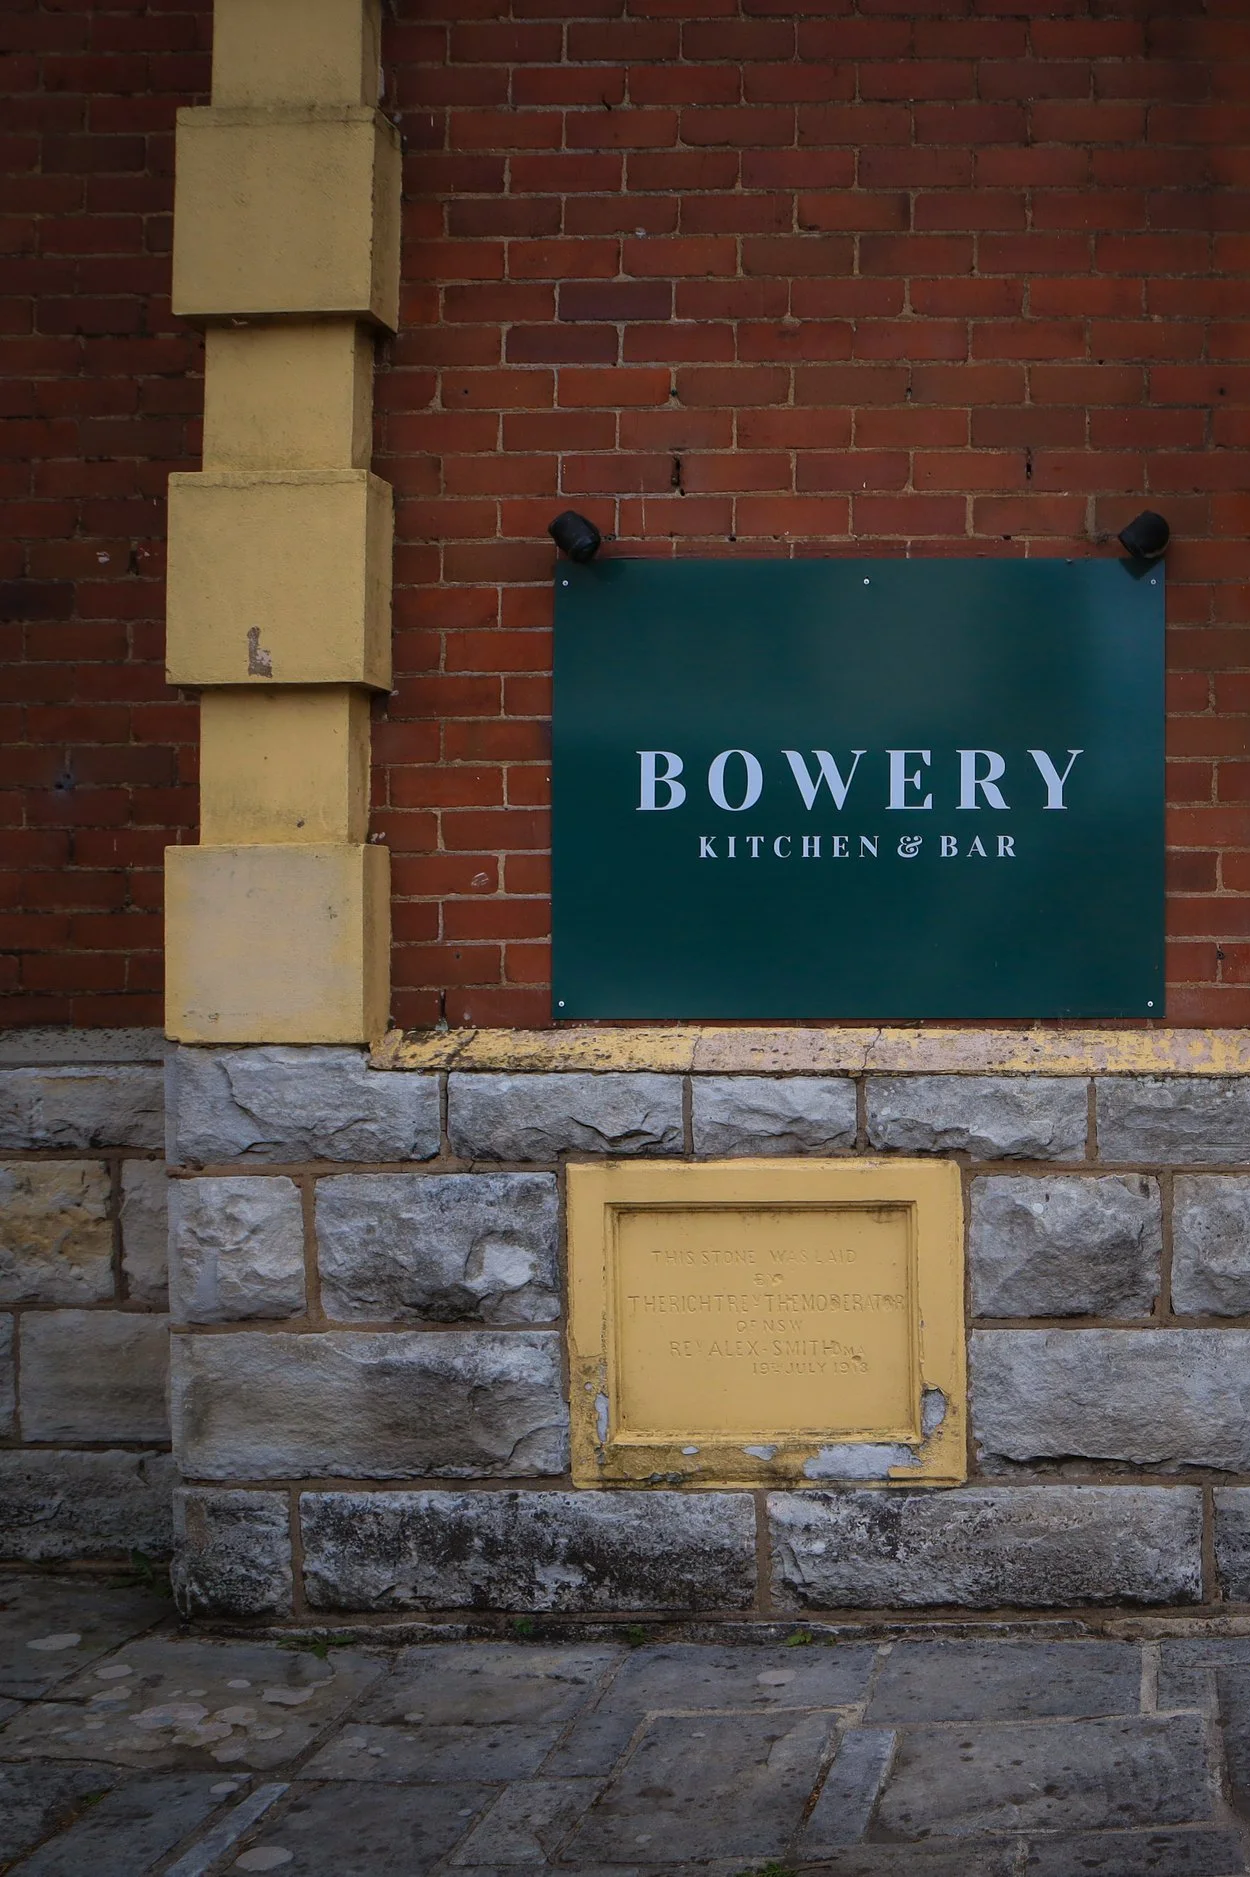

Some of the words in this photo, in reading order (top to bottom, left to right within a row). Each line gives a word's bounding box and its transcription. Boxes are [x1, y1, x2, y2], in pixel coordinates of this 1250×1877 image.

[635, 749, 1084, 811] BOWERY
[699, 836, 880, 859] KITCHEN
[897, 835, 923, 858] &
[940, 835, 1017, 858] BAR
[651, 1250, 695, 1265] THIS
[700, 1250, 757, 1265] STONE
[769, 1249, 809, 1264] WAS
[815, 1249, 857, 1264] LAID
[753, 1272, 784, 1287] BY
[627, 1295, 667, 1313] THE
[764, 1293, 799, 1313] THE
[736, 1319, 758, 1334] OF
[763, 1319, 803, 1334] NSW
[785, 1362, 826, 1375] JULY
